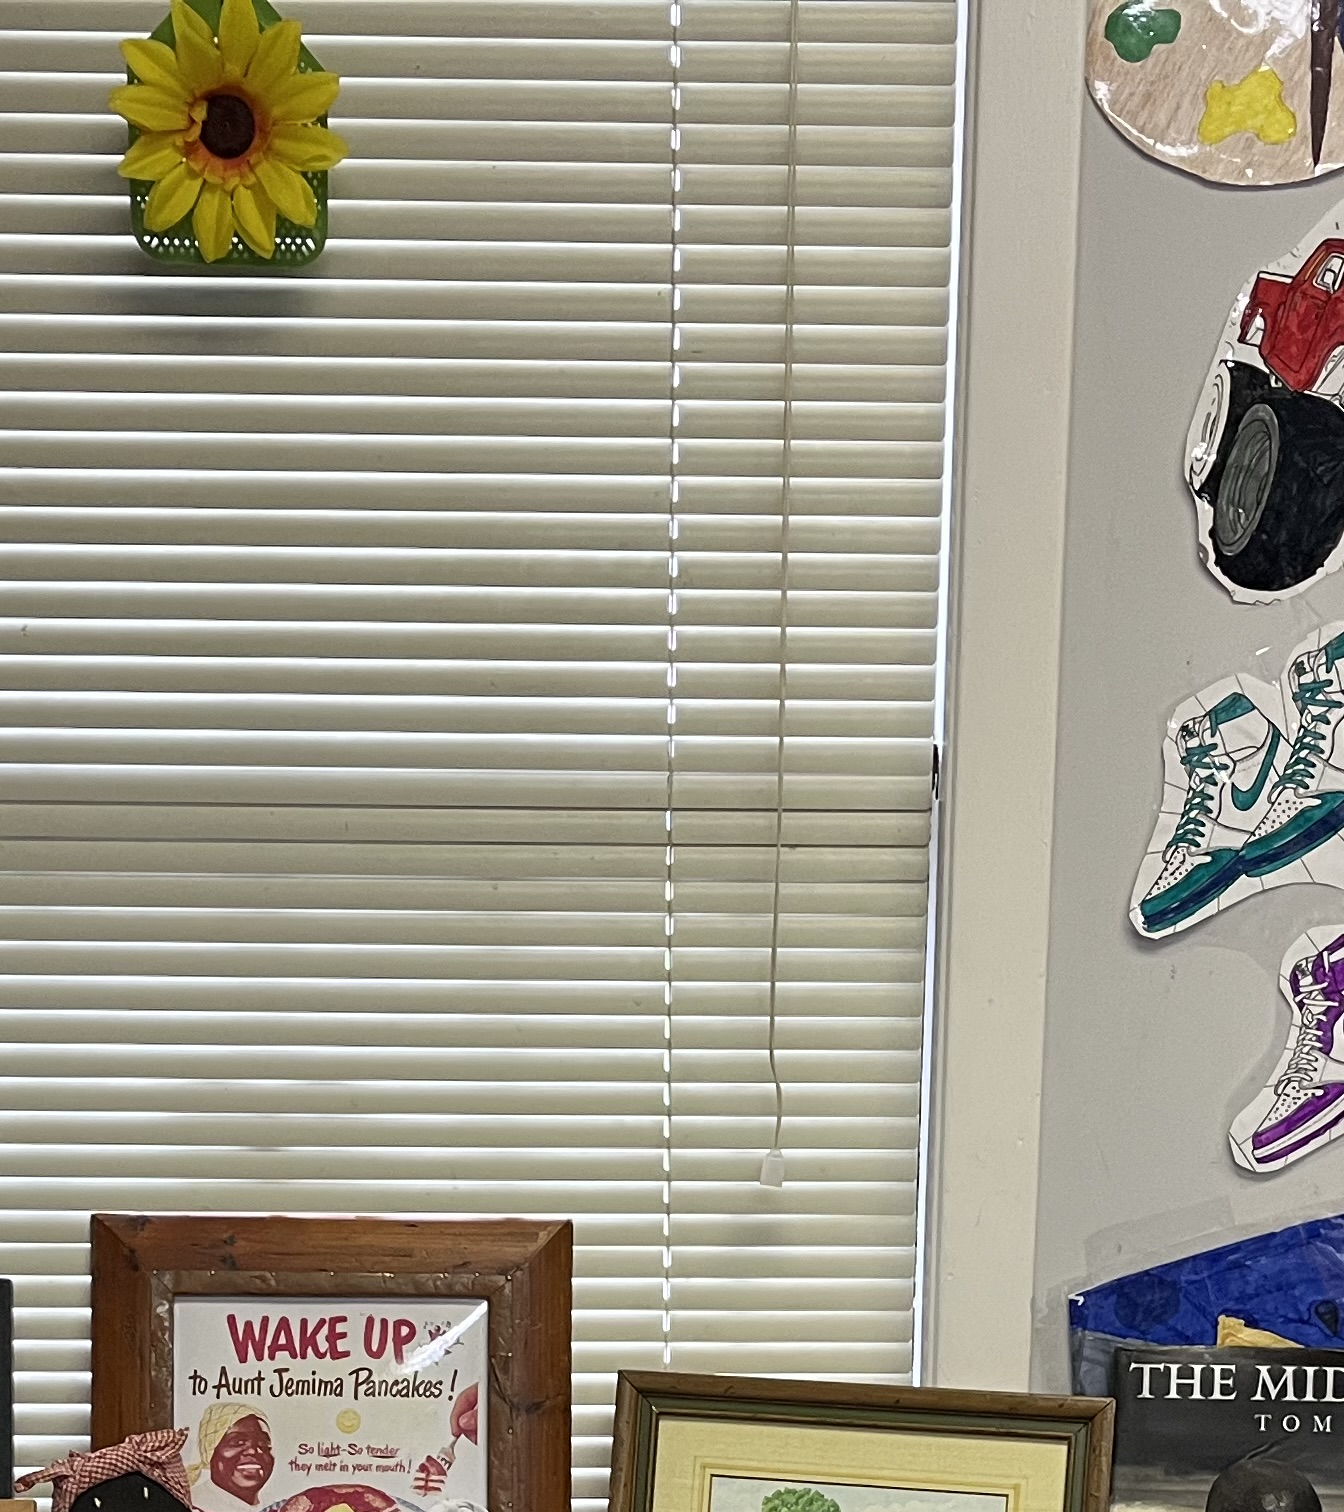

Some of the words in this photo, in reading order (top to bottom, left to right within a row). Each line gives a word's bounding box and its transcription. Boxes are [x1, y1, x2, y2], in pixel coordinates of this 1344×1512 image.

[226, 1313, 351, 1364] WAKE
[362, 1314, 417, 1365] UP
[188, 1368, 208, 1396] to
[212, 1365, 266, 1399] Aunt
[269, 1367, 344, 1398] Jemima
[1129, 1361, 1237, 1400] THE
[1254, 1412, 1335, 1434] TOM
[297, 1443, 315, 1456] So
[365, 1444, 401, 1459] tender
[288, 1456, 313, 1477] they
[315, 1459, 338, 1473] melt
[339, 1460, 350, 1473] in
[352, 1462, 374, 1476] your
